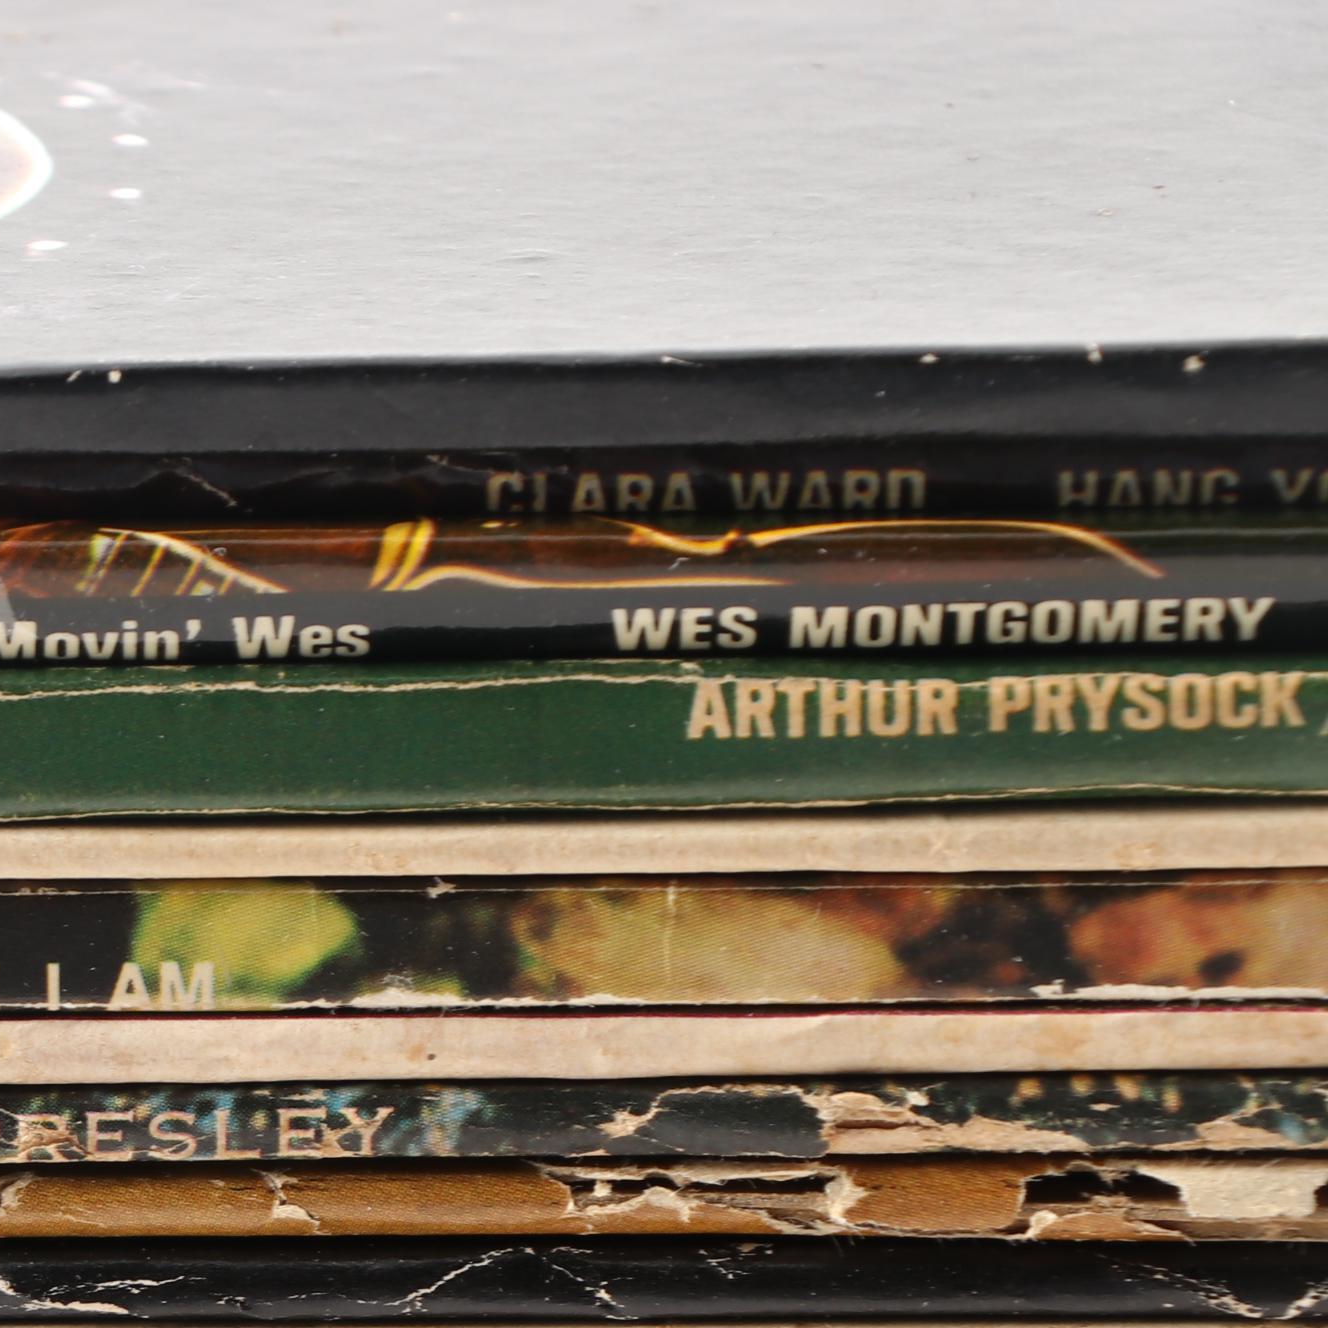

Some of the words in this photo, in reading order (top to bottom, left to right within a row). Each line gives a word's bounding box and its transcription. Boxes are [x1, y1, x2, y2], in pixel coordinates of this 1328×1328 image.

[486, 470, 694, 513] CLARA
[731, 468, 927, 510] WARD
[1058, 467, 1239, 508] HANG
[1272, 465, 1328, 504] Y
[232, 614, 371, 658] Wes
[612, 606, 758, 652] WES
[790, 596, 1277, 650] MONTGOMERY
[687, 676, 959, 740] ARTHUR
[987, 669, 1307, 735] PRYSOCK
[47, 962, 62, 1012] I
[109, 961, 218, 1012] AM
